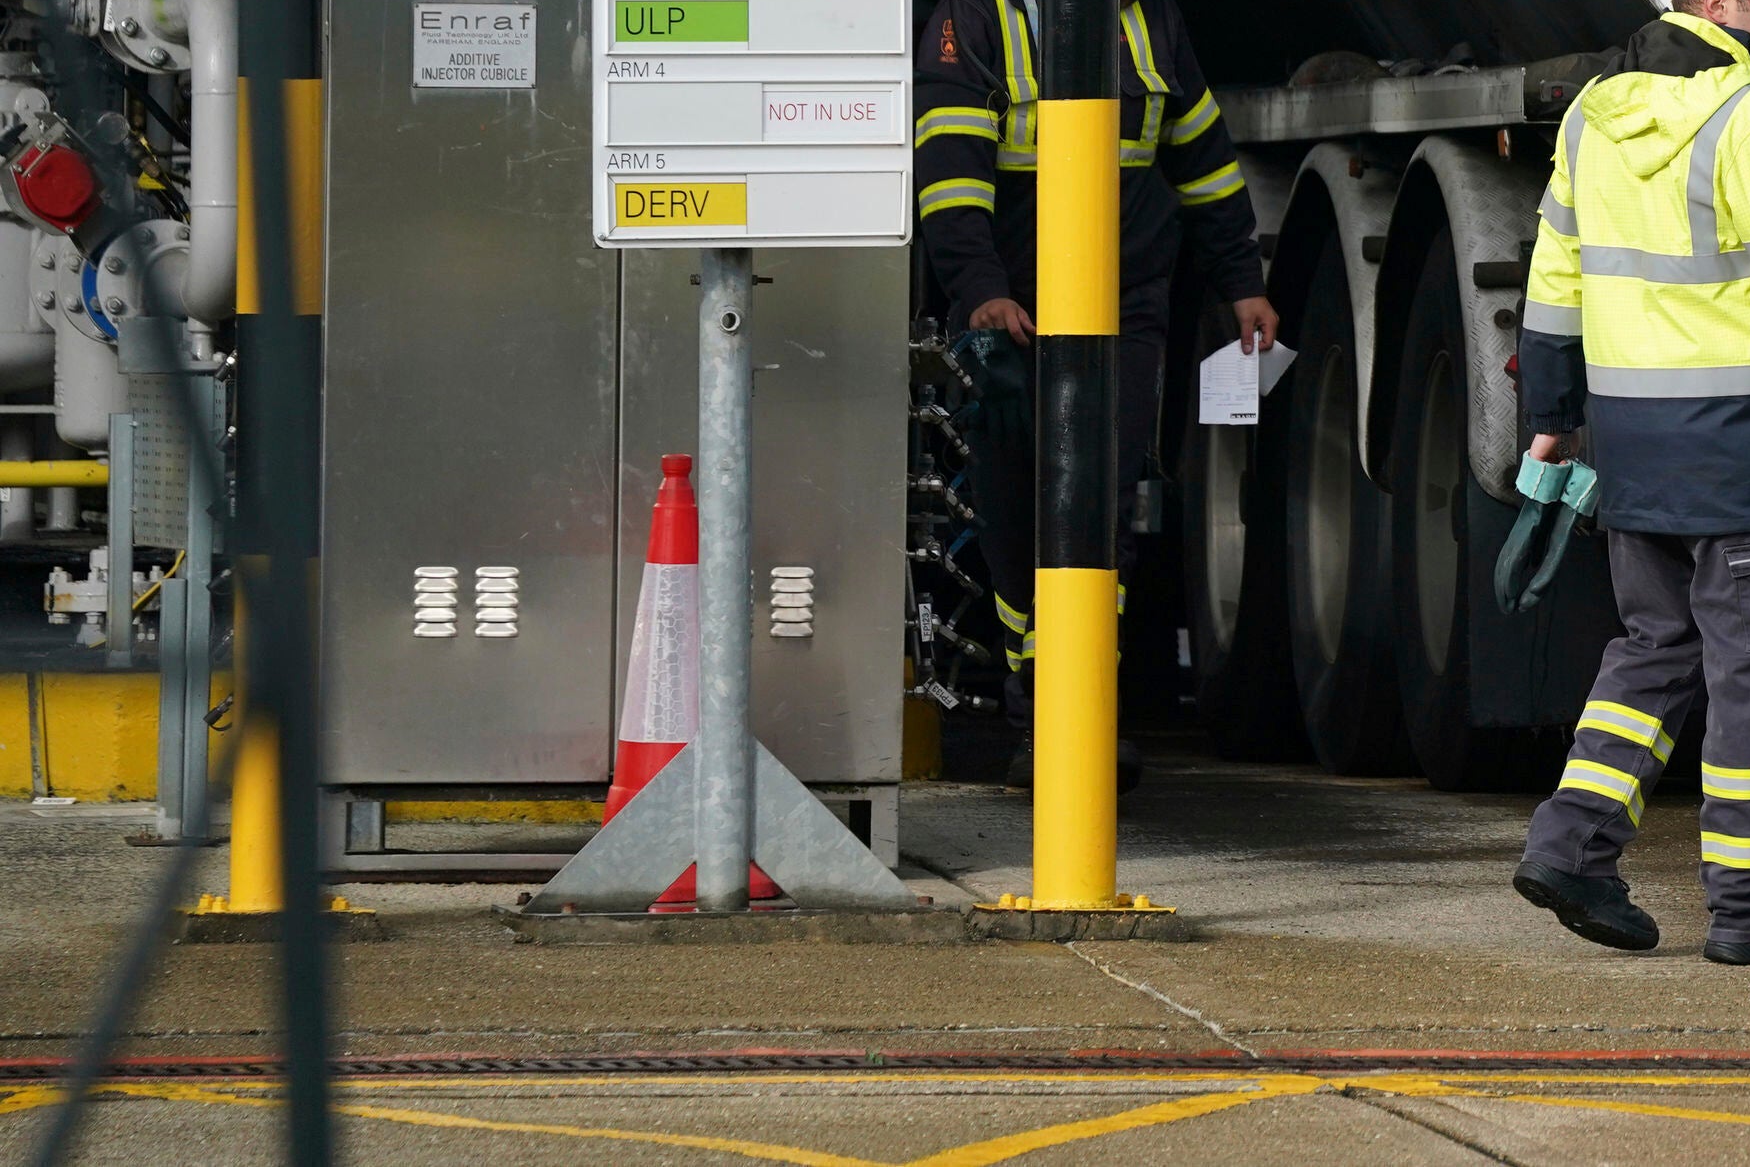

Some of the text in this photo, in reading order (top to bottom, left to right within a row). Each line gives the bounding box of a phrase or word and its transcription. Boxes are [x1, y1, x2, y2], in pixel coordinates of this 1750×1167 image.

[421, 11, 531, 30] Enraf
[625, 6, 685, 35] ULP
[448, 53, 501, 66] ADDITIVE
[421, 67, 528, 81] INJECTOR CUBICLE
[607, 62, 666, 78] ARM 4
[769, 103, 877, 121] NOT IN USE
[607, 153, 666, 169] ARM 5
[625, 190, 710, 218] DERV
